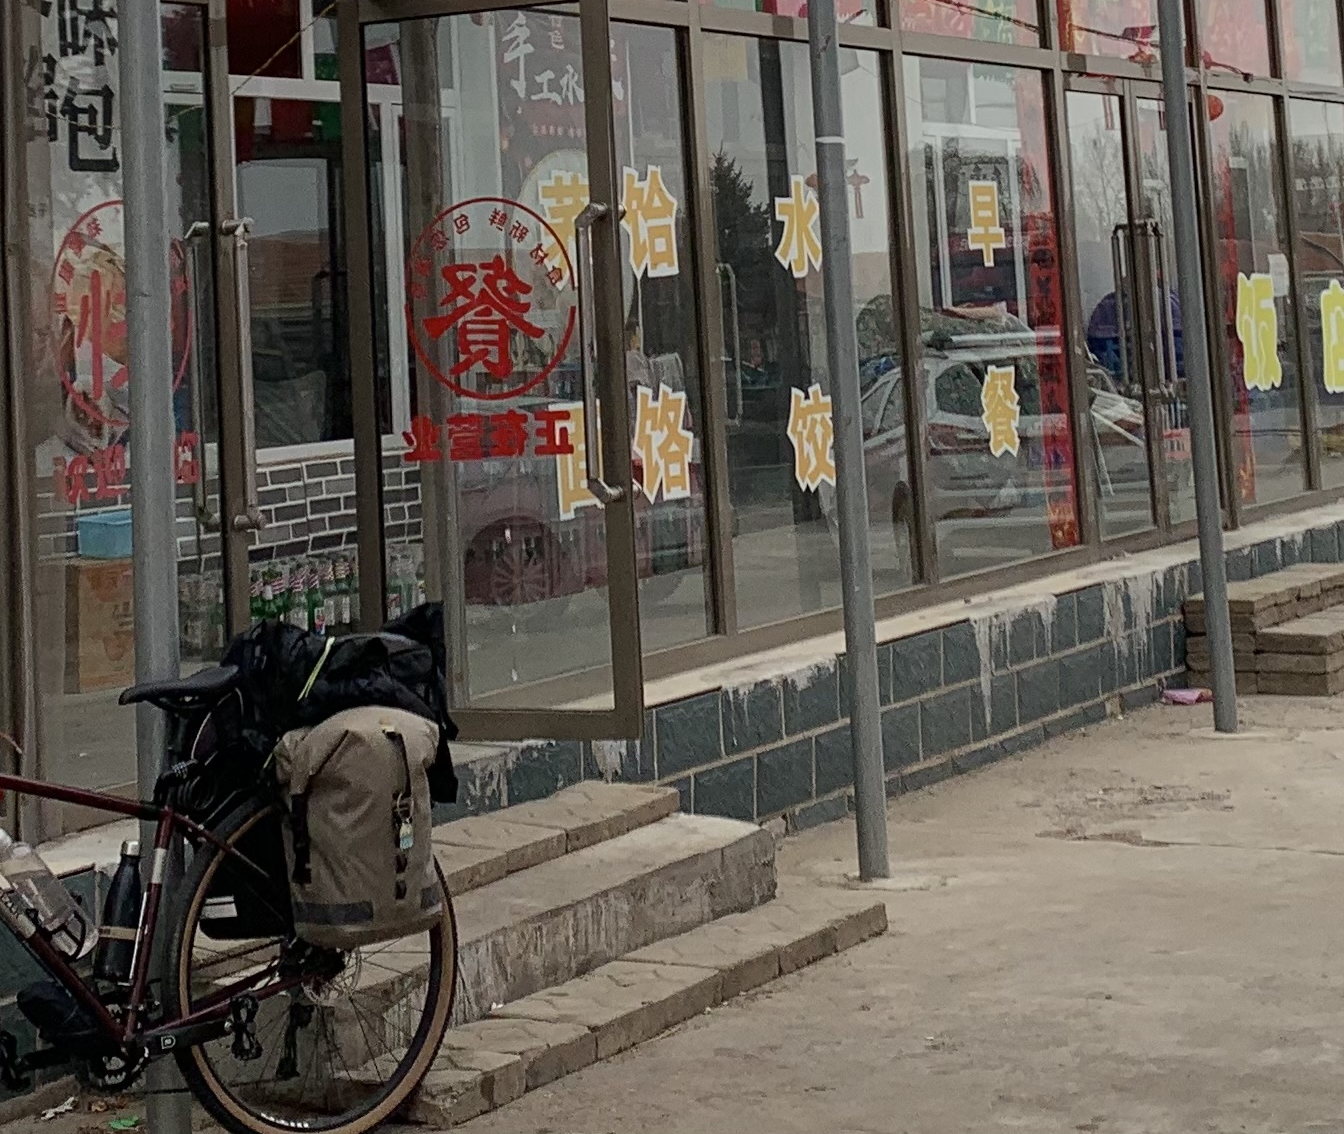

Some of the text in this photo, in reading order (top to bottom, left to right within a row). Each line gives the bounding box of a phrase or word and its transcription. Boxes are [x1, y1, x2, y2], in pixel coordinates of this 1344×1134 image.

[502, 10, 624, 105] 手工水
[774, 175, 836, 493] 水饺
[967, 179, 1020, 458] 早餐
